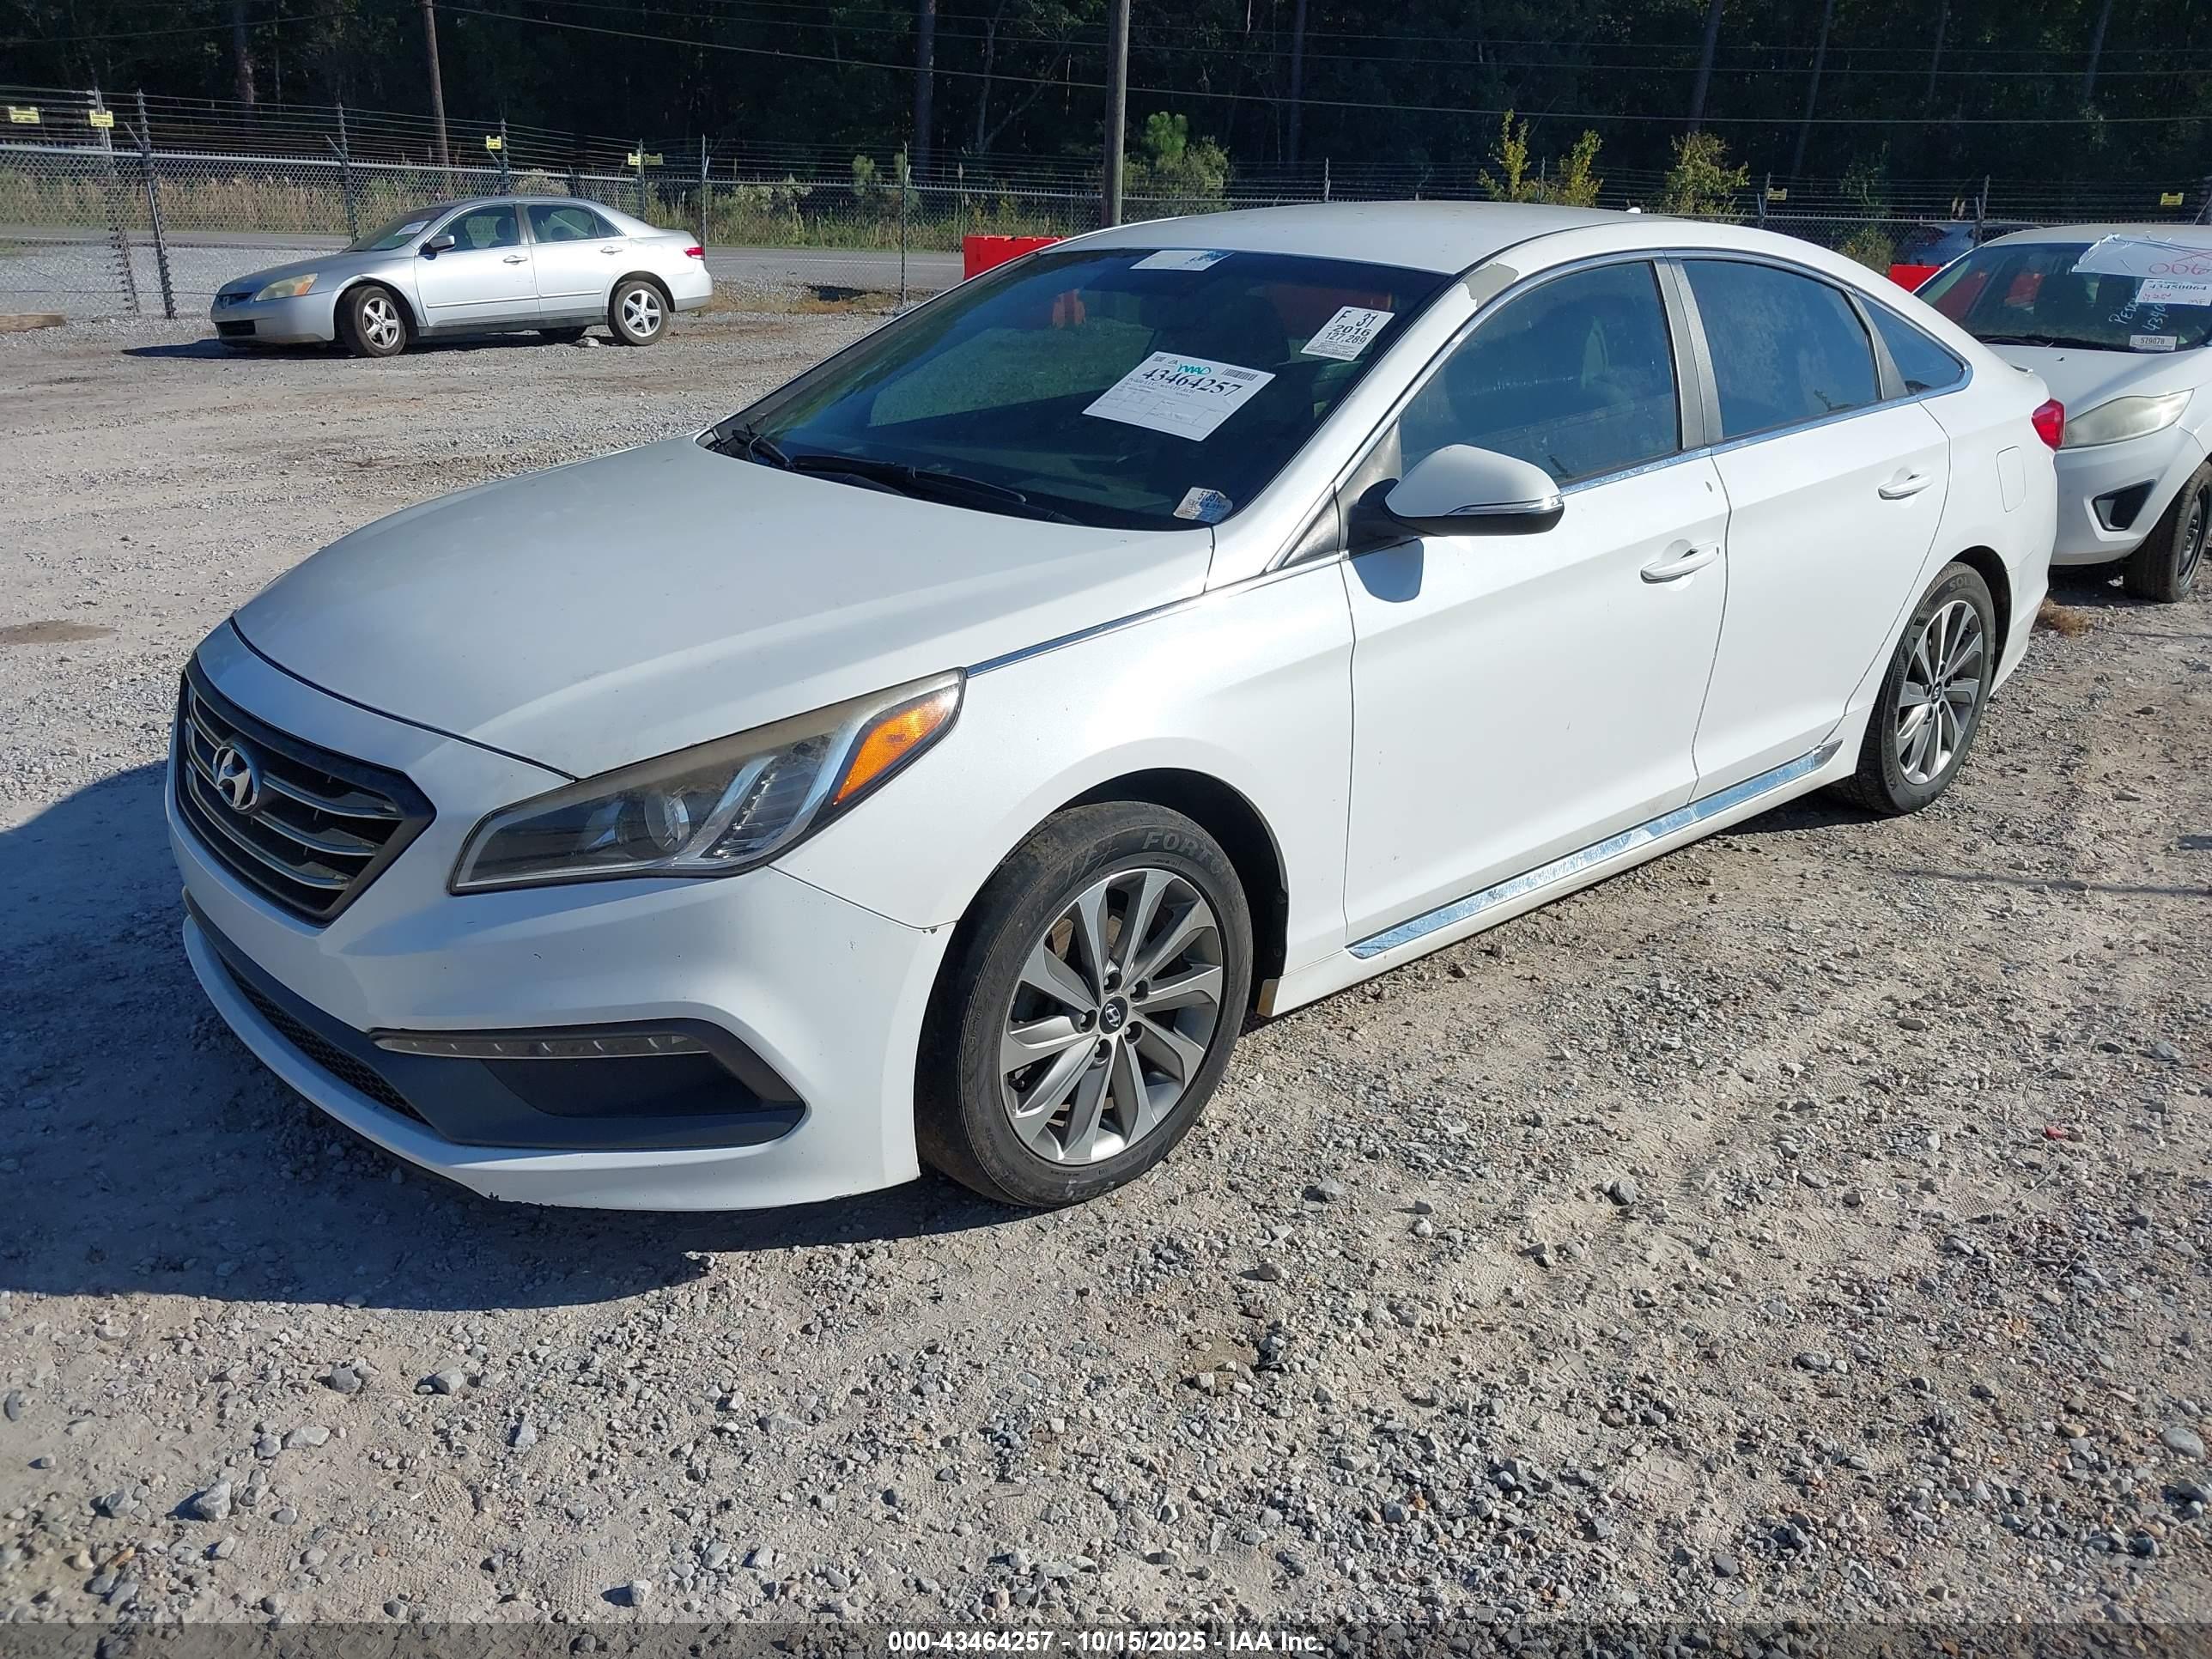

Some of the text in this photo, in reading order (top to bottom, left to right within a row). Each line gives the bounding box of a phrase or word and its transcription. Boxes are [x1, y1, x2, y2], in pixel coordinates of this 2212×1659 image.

[1356, 313, 1379, 328] 31
[1325, 331, 1368, 345] 127,289
[1333, 325, 1372, 337] 2016
[1142, 368, 1244, 397] 43464257
